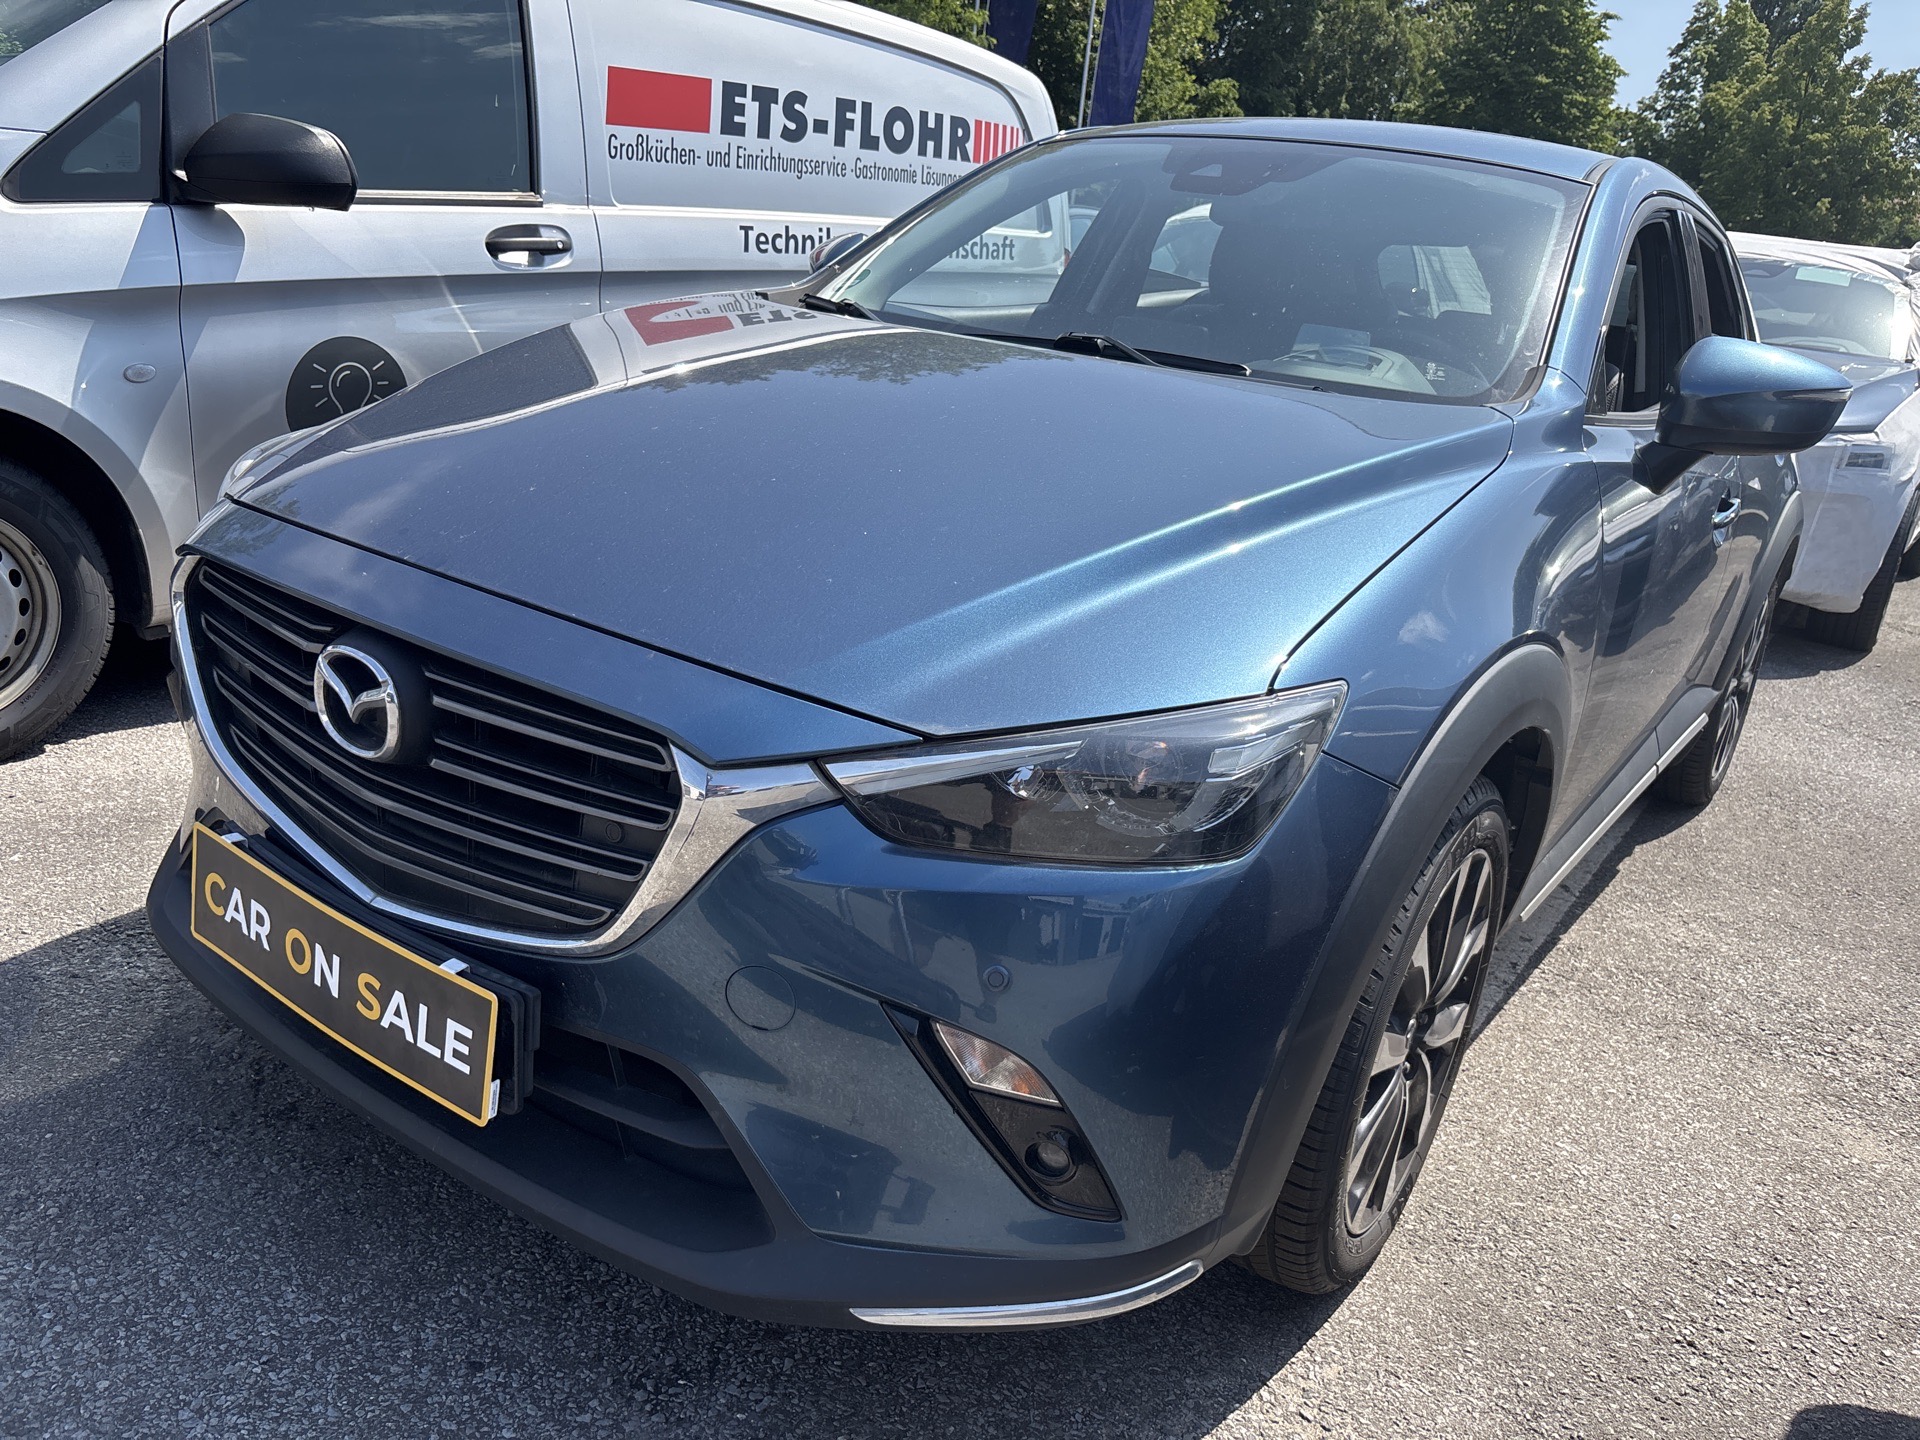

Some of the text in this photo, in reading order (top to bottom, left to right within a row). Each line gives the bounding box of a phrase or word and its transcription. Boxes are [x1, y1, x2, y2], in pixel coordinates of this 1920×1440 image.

[607, 133, 702, 166] Großküchen-
[706, 142, 731, 168] und
[736, 145, 848, 179] Einrichtungsservice
[921, 164, 962, 187] Lösunge
[719, 80, 972, 163] ETS-FLOHR
[203, 871, 473, 1075] CAR ON SALE
